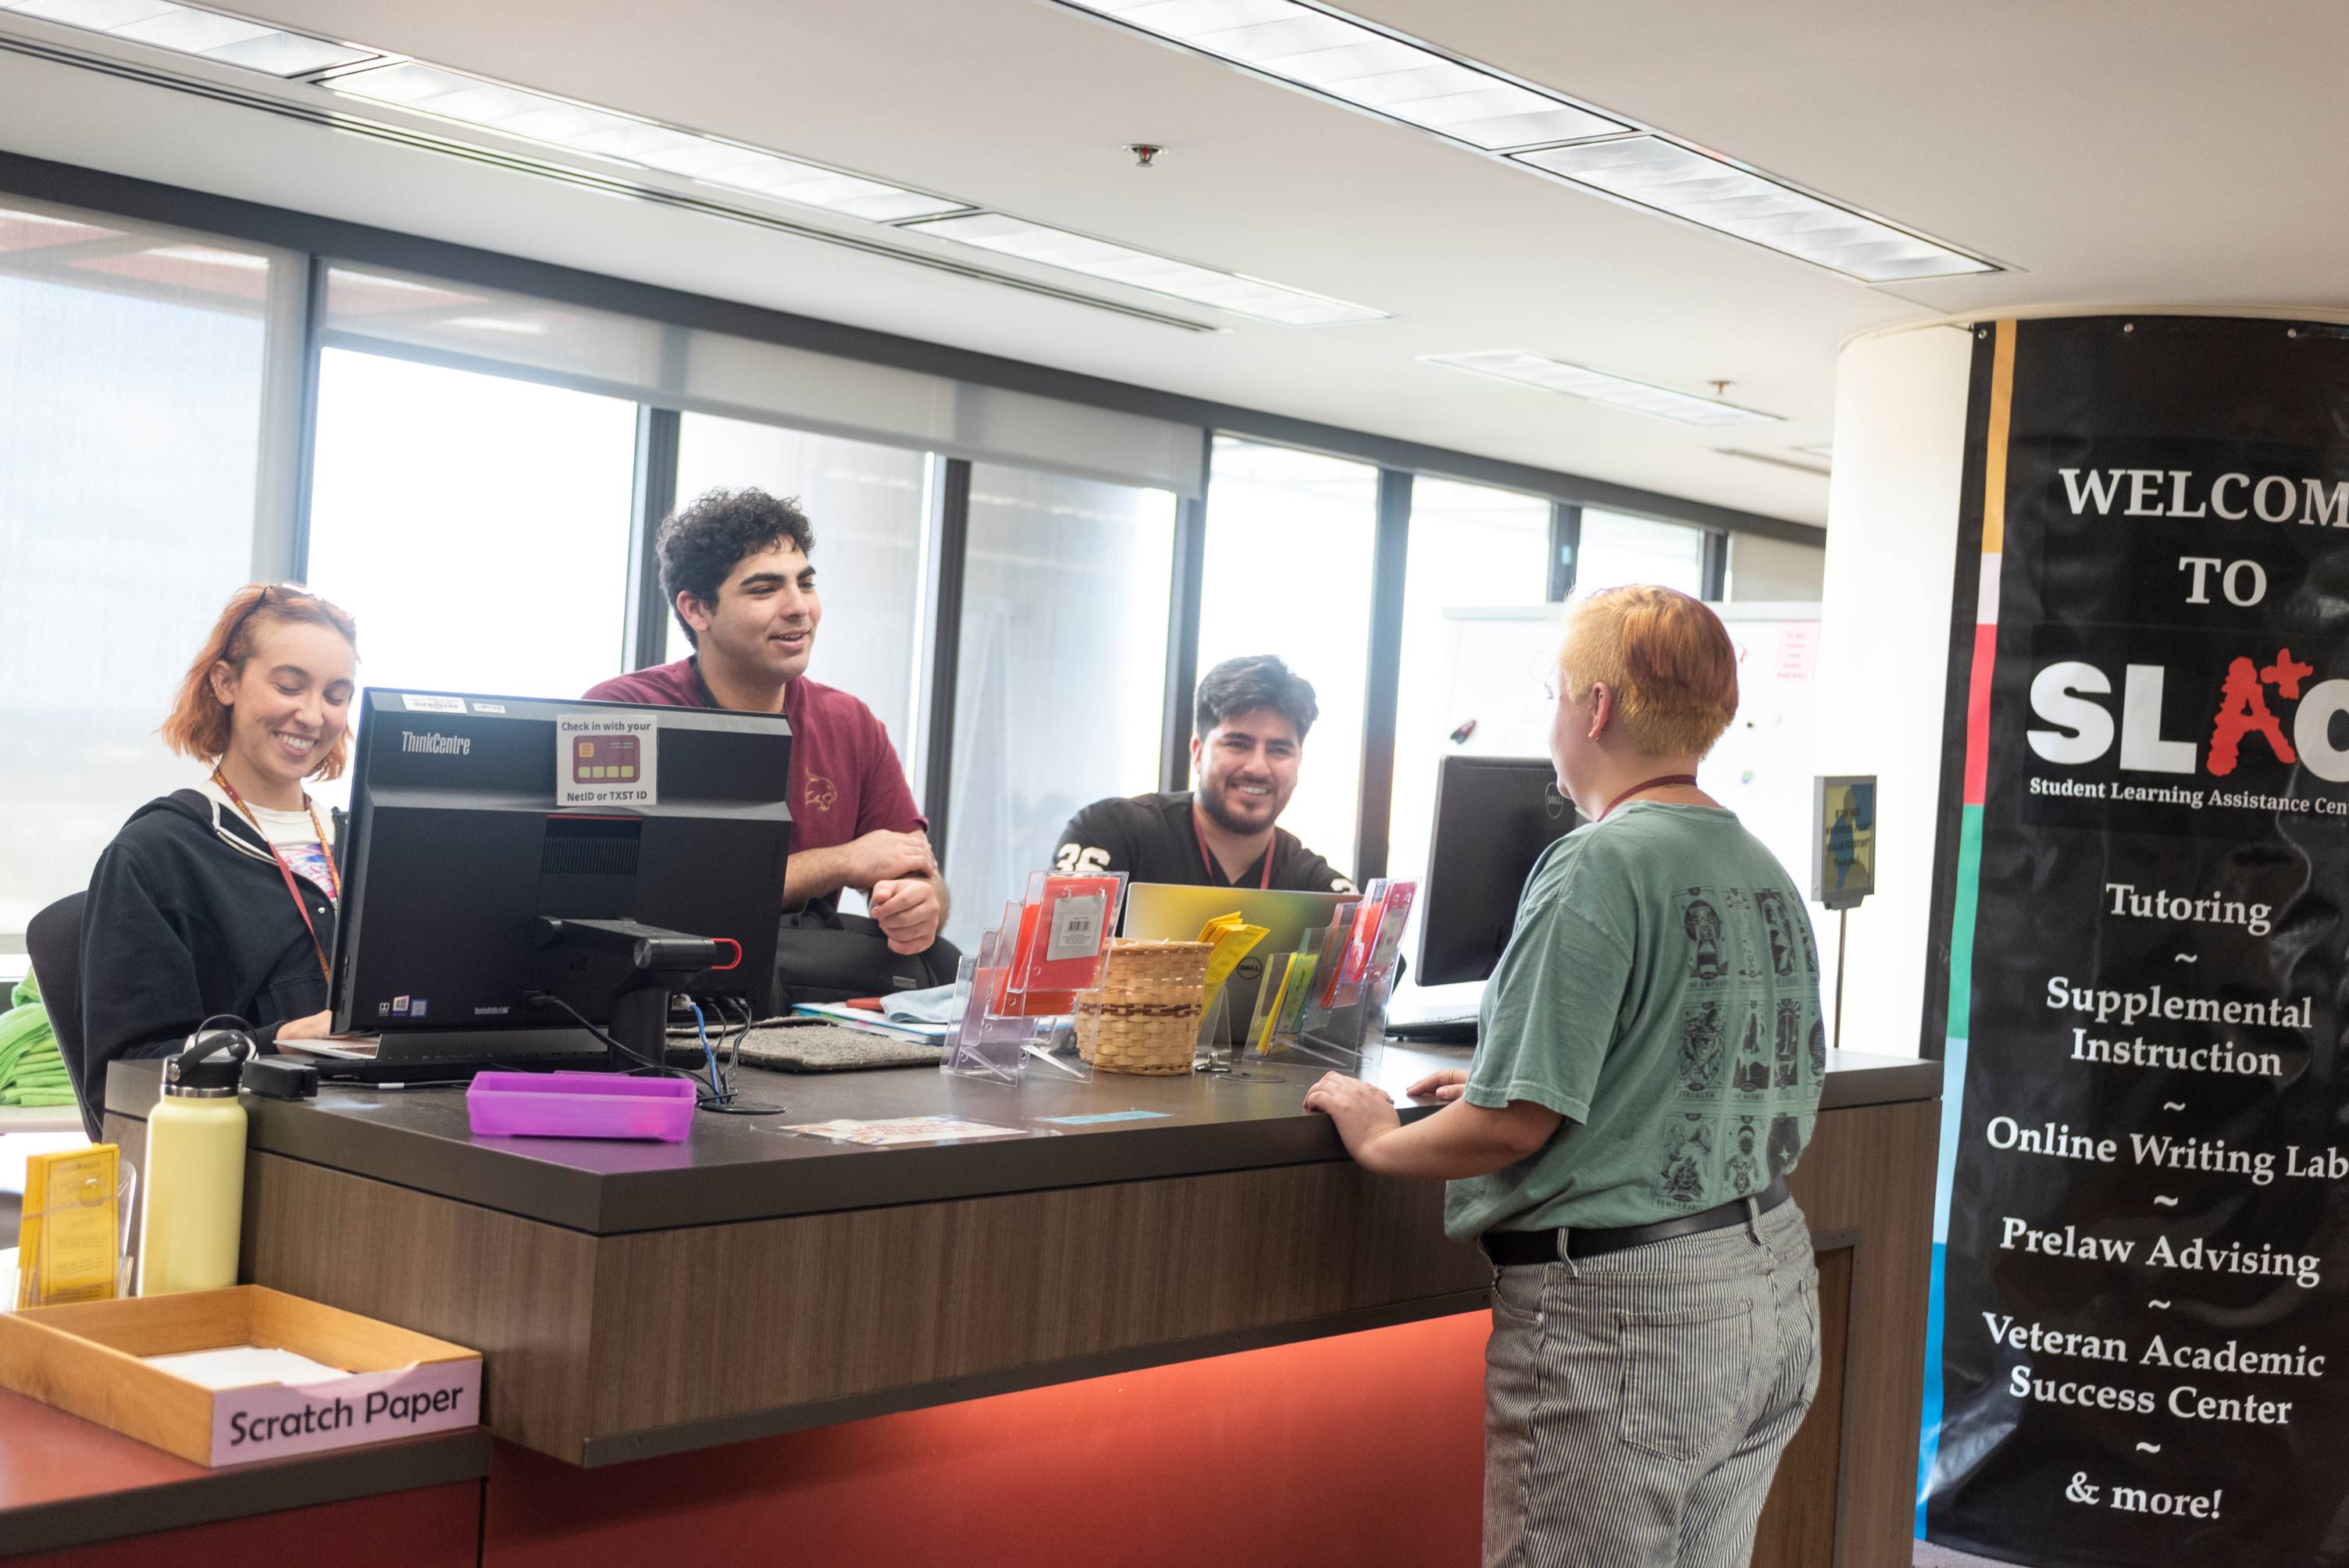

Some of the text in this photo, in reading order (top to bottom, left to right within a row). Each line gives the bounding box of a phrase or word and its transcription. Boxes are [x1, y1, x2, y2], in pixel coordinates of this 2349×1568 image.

[2179, 557, 2267, 607] TO
[402, 731, 470, 755] ThinkCentre
[561, 722, 651, 732] Check in with your
[567, 793, 594, 801] NetID
[610, 791, 633, 800] TXST
[636, 791, 647, 800] ID
[2030, 777, 2349, 815] Student Learning Assistance Cen
[2106, 882, 2272, 936] Tutoring
[2046, 976, 2312, 1028] Supplemental
[2070, 1028, 2283, 1077] Instruction
[1986, 1117, 2349, 1185] Online Writing Lab
[1999, 1217, 2320, 1288] Prelaw Advising
[1982, 1312, 2326, 1377] Veteran Academic
[230, 1387, 464, 1446] Scratch Paper
[2009, 1365, 2293, 1424] Success Center
[2065, 1471, 2223, 1520] & more!
